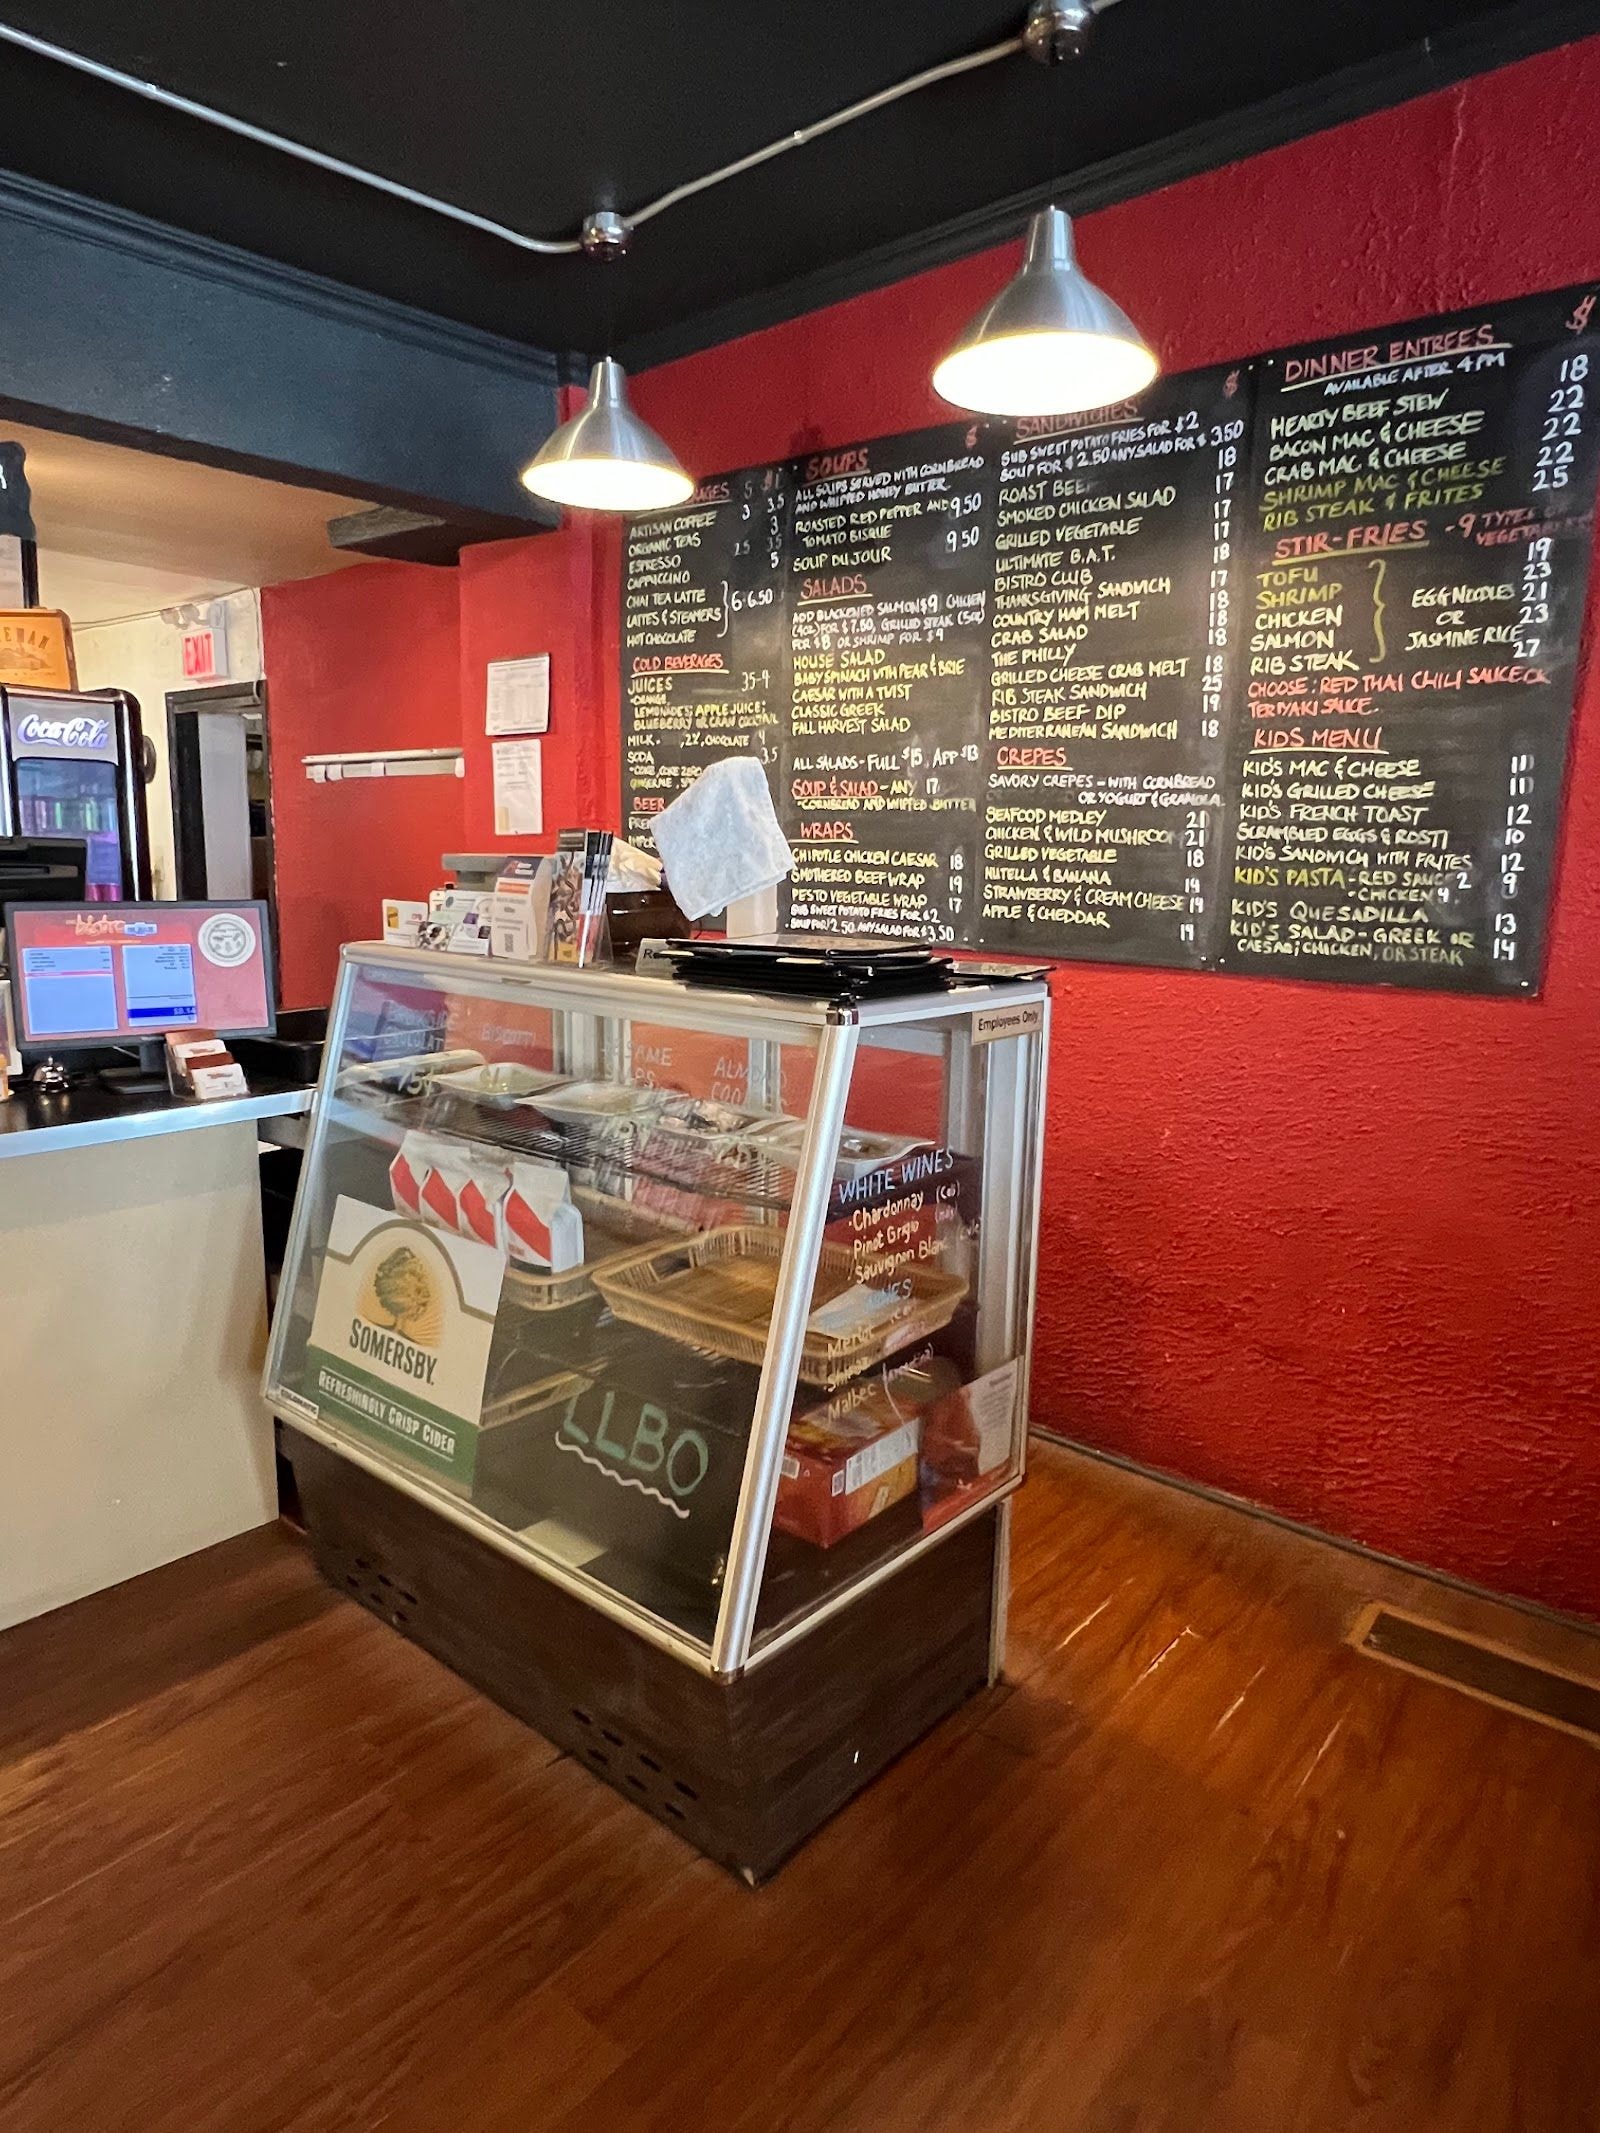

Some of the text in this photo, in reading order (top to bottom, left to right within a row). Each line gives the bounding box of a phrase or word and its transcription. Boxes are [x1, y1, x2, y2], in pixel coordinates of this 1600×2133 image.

[1285, 325, 1493, 382] DINNER ENTREES
[1342, 355, 1589, 421] BEEF STEW 18
[1269, 385, 1585, 462] BACON MAC CHEESE 22
[1264, 413, 1581, 485] CRAB MAC CHEESE 22
[807, 449, 868, 479] SOUPS
[999, 447, 1237, 506] ROAST 18
[1260, 442, 1574, 512] SHRIMP MAC CHEESE 22
[997, 472, 1234, 527] SMOKED CHICKEN 17
[1263, 466, 1569, 531] RIB STEAK FRITES 25
[674, 511, 718, 529] COFFEE
[795, 503, 922, 535] ROASTED RED PEPPER
[995, 500, 1231, 550] GRILLED VEGETABLE 17
[628, 532, 701, 557] ORGANIC TEAS
[803, 525, 893, 548] TOMATO BISQUE
[629, 555, 681, 574] ESPRESSO
[793, 547, 892, 572] SOUP DU JOUR
[995, 544, 1230, 592] BISTRO 18
[1257, 538, 1552, 587] TOFU 19
[801, 574, 867, 599] SALADS
[1211, 570, 1228, 587] 17
[1256, 563, 1551, 610] SHRIMP 23
[626, 588, 706, 609] CHAI TEA LATTE
[993, 591, 1229, 628] COUNTRY HAM MELT 18
[1255, 587, 1548, 629] CHICKEN 21
[627, 608, 721, 628] LATTES STEAMERS
[1519, 605, 1548, 624] 23
[627, 633, 645, 647] HOT
[991, 624, 1088, 648] CRAB SALAD
[1250, 630, 1334, 651] SALMON
[184, 630, 214, 677] EXIT
[633, 654, 724, 672] COLD BEVERAGES
[794, 649, 885, 669] HOUSE SALAD
[1021, 643, 1076, 666] PHILLY
[1250, 650, 1359, 675] RIB STEAK
[794, 663, 928, 686] BABY PEAR
[991, 656, 1224, 686] GRILLED CHEESE CRAB MELT 18
[628, 677, 672, 694] JUICES
[992, 676, 1222, 706] RIB STEAK SANDWICH 25
[1319, 672, 1403, 693] RED THAI
[792, 687, 874, 703] CAESAR A
[792, 703, 885, 719] CLASSIC GREEK
[990, 704, 1126, 724] BISTRO BEEF DIP
[792, 718, 911, 736] FALL HARVEST SALAD
[1201, 720, 1220, 737] 18
[1253, 726, 1383, 748] KIDS MENU
[628, 751, 654, 764] SODA
[793, 757, 813, 771] ALL
[997, 747, 1066, 766] CREPES
[1289, 759, 1421, 777] MAC CHEESE
[792, 779, 826, 797] SOUP
[988, 774, 1093, 788] SAVORY CREPES
[1286, 783, 1359, 800] GRILLED
[986, 807, 1107, 826] SEAFOOD MEDLEY
[1362, 805, 1531, 825] TOAST 12
[801, 822, 853, 839] WRAPS
[1054, 828, 1090, 843] WILD
[844, 849, 939, 868] CHICKEN CAESAR
[1501, 854, 1524, 872] 12
[855, 869, 925, 889] BEEF WRAP
[1052, 868, 1112, 885] BANANA
[792, 888, 889, 906] PESTO VEGETABLE
[1085, 890, 1132, 907] CREAM
[1038, 906, 1110, 928] CHEDDAR
[1231, 900, 1516, 934] KID'S QUESADILLA 13
[1230, 920, 1279, 940] KID'S
[978, 1010, 1039, 1032] Employees Only
[839, 1168, 896, 1204] WHITE
[901, 1146, 954, 1184] WINES
[852, 1191, 924, 1231] Chardonnay
[854, 1231, 884, 1260] Pinot
[854, 1250, 914, 1285] Sauvignon
[350, 1318, 438, 1384] SOMERSBY
[318, 1370, 386, 1420] REFRESHINGLY
[388, 1407, 419, 1435] CRISP
[422, 1424, 456, 1455] CIDER
[828, 1383, 877, 1422] Malbec
[561, 1386, 709, 1496] LLBO
